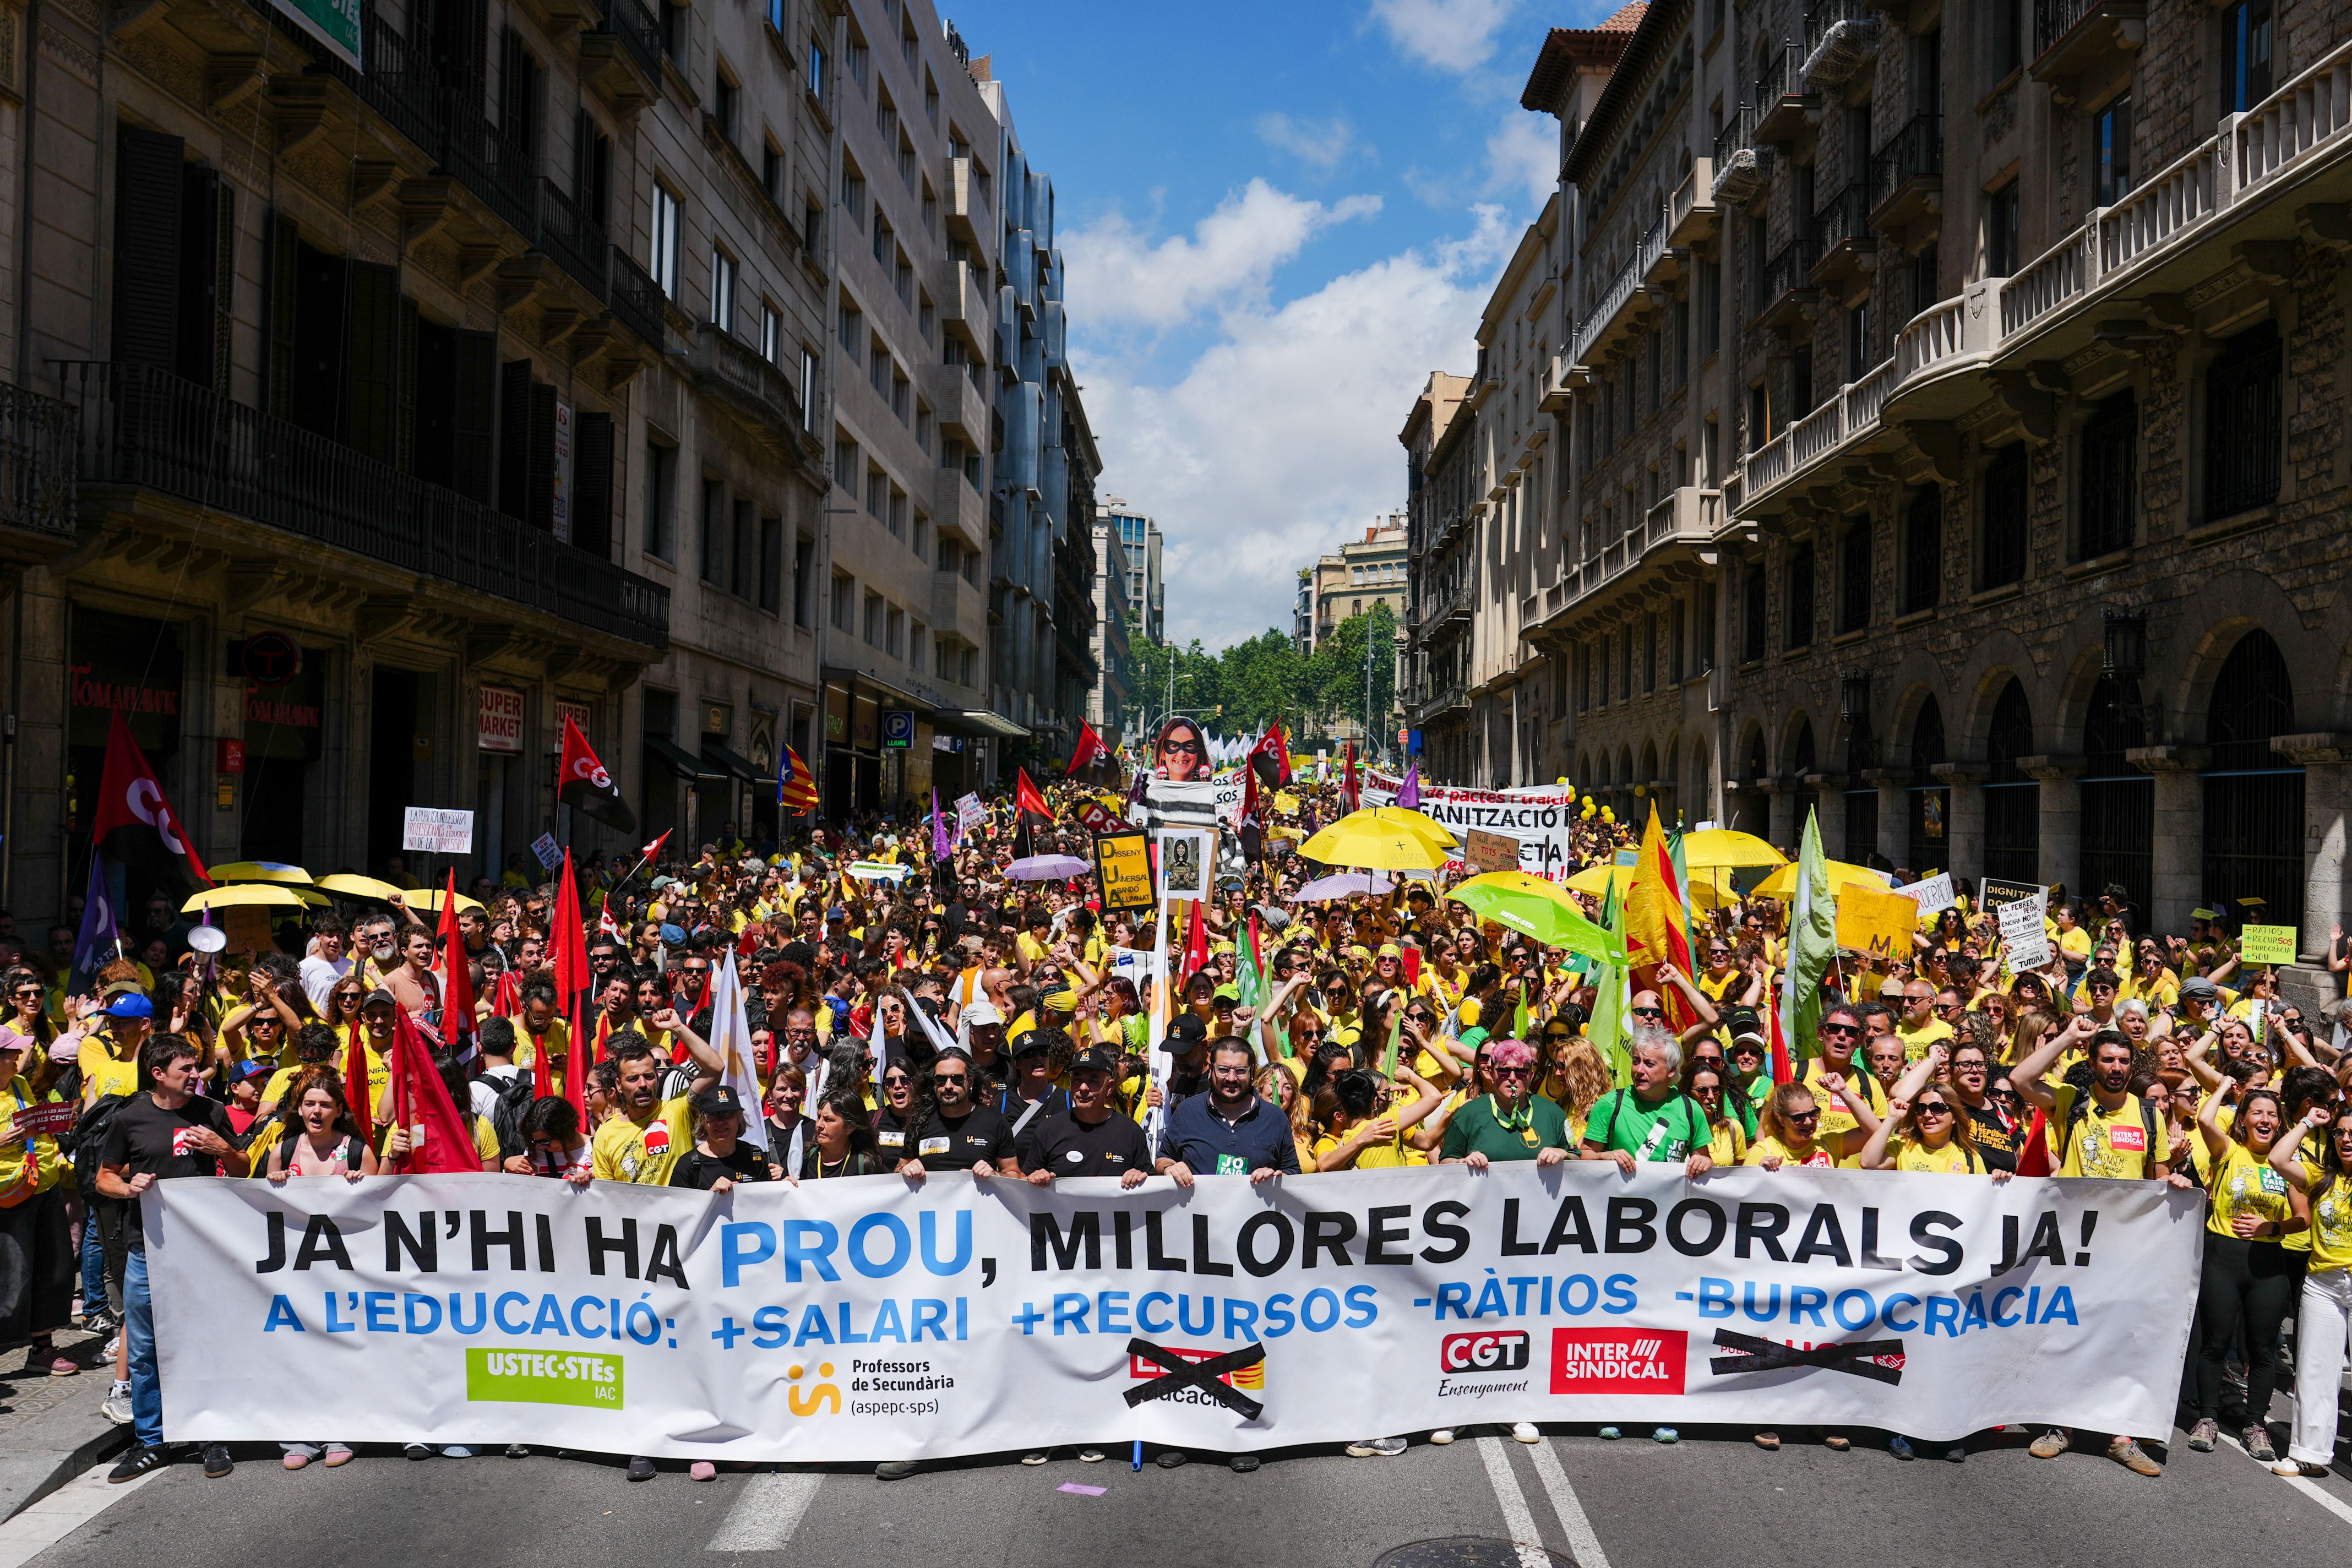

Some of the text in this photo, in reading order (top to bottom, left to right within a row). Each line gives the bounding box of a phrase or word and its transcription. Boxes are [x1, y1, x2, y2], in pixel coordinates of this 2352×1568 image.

[478, 688, 521, 717] SUPER
[478, 713, 521, 739] MARKET
[1425, 787, 1445, 799] de
[1449, 788, 1506, 806] pactes
[410, 810, 418, 822] LA
[440, 810, 466, 825] NECESSITA
[407, 823, 445, 837] PROFESSIONALS
[409, 836, 416, 848] NO
[417, 837, 423, 849] DE
[426, 837, 433, 850] LA
[1476, 834, 1507, 848] Vull poder
[1390, 853, 1427, 864] RECURSOS
[1481, 846, 1496, 857] TOTS
[1481, 858, 1496, 866] meus
[1845, 887, 1890, 908] L'ESCOLA
[1843, 899, 1894, 921] HOGWARTS
[2011, 899, 2035, 911] FEBRER
[2001, 919, 2021, 928] ENCARA
[2022, 914, 2031, 923] NO
[2003, 919, 2041, 935] POGUT TORNAR
[1837, 927, 1849, 939] HI
[1852, 930, 1866, 947] HA
[2018, 954, 2045, 968] TUTORA
[1978, 1128, 2012, 1142] REPÚBLICA
[1978, 1133, 2006, 1145] COMENÇA
[2112, 1136, 2143, 1145] SINDICAL
[647, 1144, 669, 1155] CGT
[1668, 1139, 1685, 1152] JO
[1991, 1141, 2013, 1153] AULES
[1221, 1156, 1244, 1169] JO
[2263, 1178, 2285, 1188] FAIG
[2264, 1184, 2285, 1192] VAGA
[256, 1211, 355, 1274] JA
[584, 1216, 690, 1291] HA
[720, 1210, 997, 1289] PROU,
[1028, 1200, 1472, 1278] MILLORES
[1500, 1196, 1964, 1277] LABORALS
[1990, 1210, 2099, 1278] JA!
[263, 1294, 306, 1333] A
[711, 1295, 968, 1351] +SALARI
[1011, 1284, 1378, 1343] +RECURSOS
[1447, 1335, 1525, 1370] CGT
[1567, 1342, 1630, 1362] INTER
[852, 1358, 930, 1373] Professors
[1565, 1361, 1669, 1380] SINDICAL
[851, 1374, 954, 1392] de Secundària
[1438, 1378, 1529, 1400] Ensenyament
[595, 1385, 616, 1401] IAC
